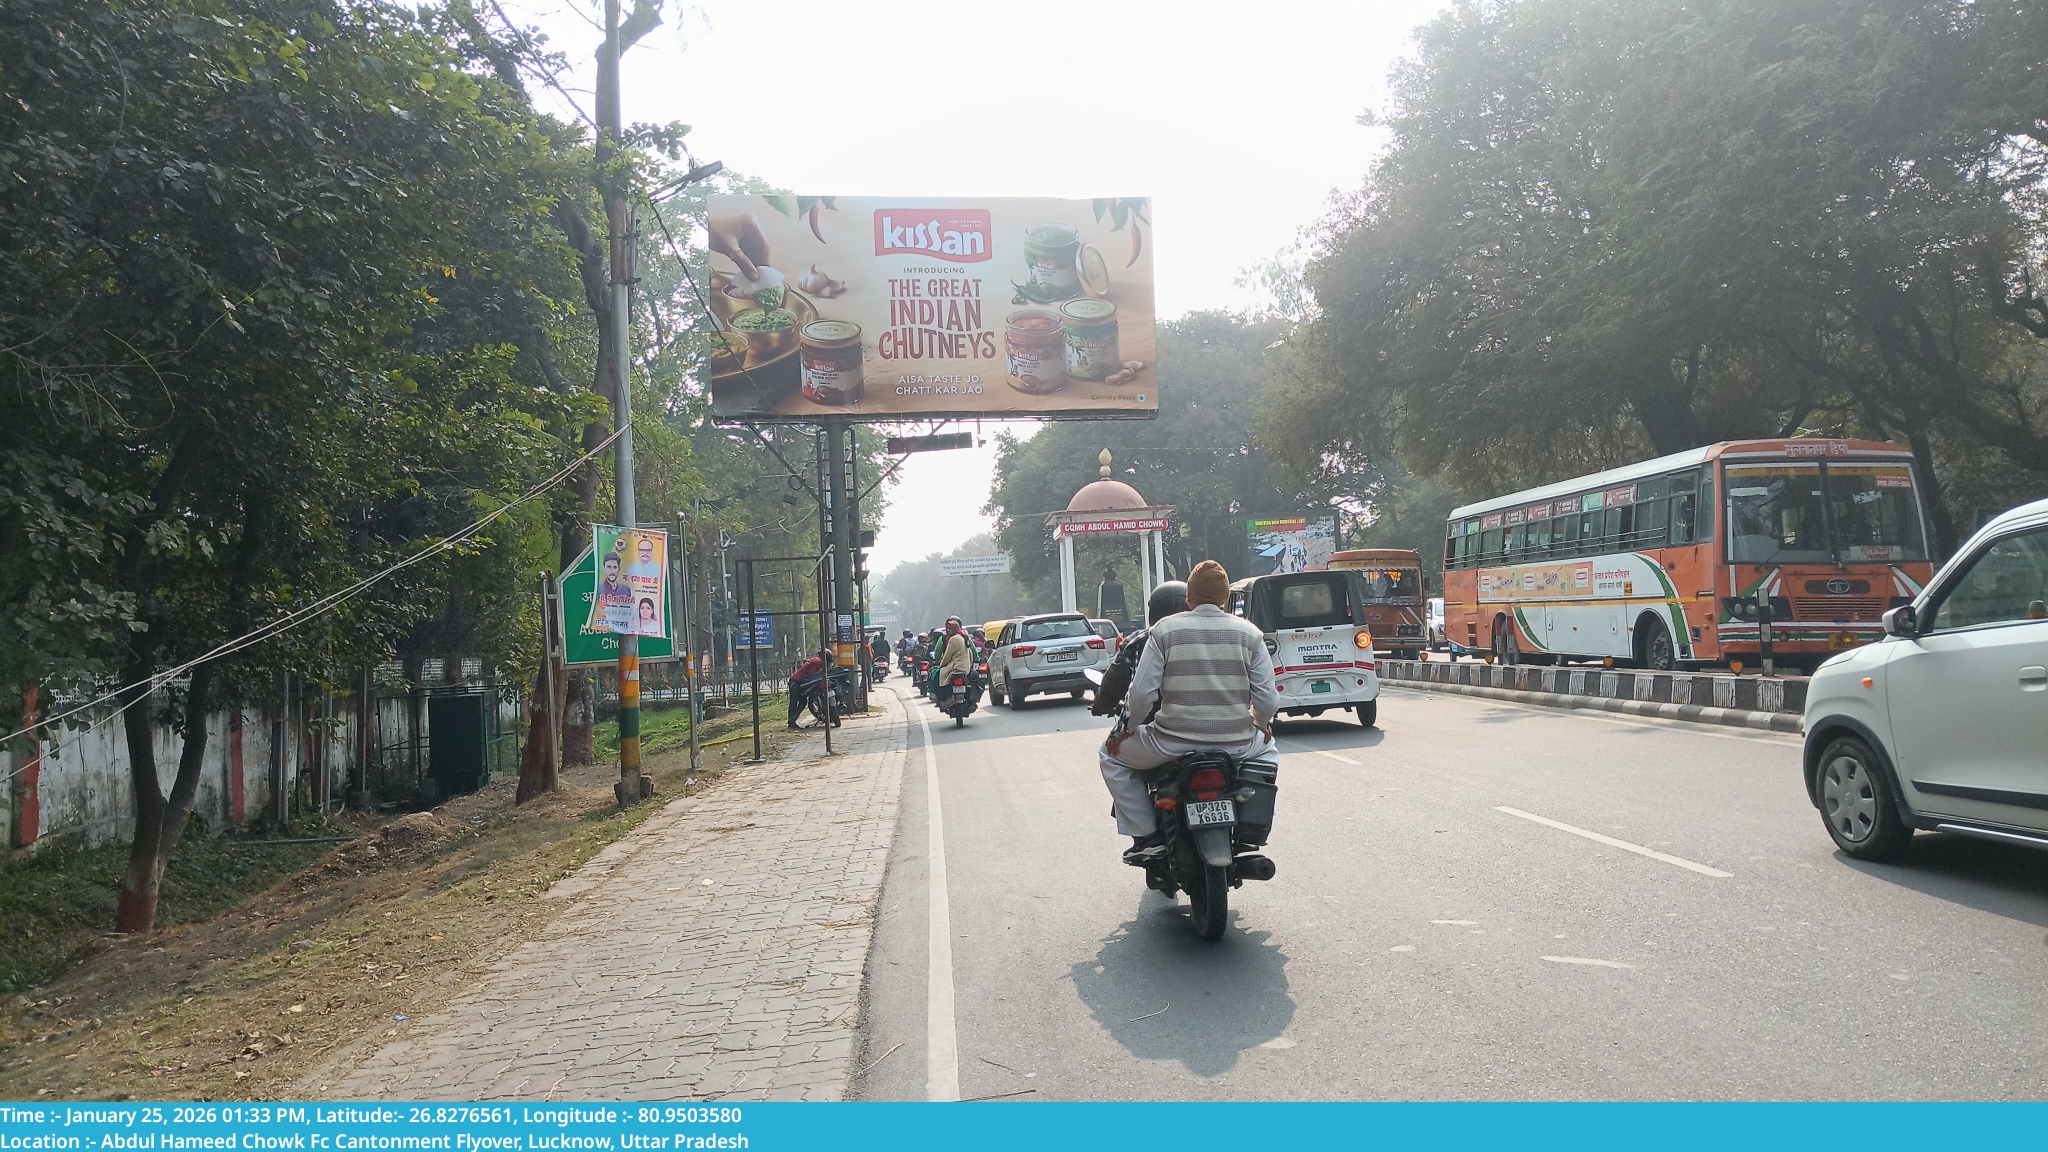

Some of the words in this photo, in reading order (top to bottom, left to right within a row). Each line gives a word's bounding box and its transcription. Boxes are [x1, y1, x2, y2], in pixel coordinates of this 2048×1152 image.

[882, 216, 985, 256] kissan
[888, 279, 921, 297] THE
[927, 279, 982, 297] GREAT
[890, 299, 981, 331] INDIAN
[878, 327, 997, 360] CHUTNEYS
[899, 375, 925, 384] AISA
[928, 375, 962, 383] TASTE
[966, 375, 980, 383] JO
[895, 386, 932, 395] CHATT
[935, 386, 958, 394] KAR
[962, 386, 983, 394] JAO
[1064, 523, 1086, 532] CQMH
[1087, 522, 1111, 531] ABDUL
[1113, 520, 1137, 529] HAMID
[1138, 519, 1165, 528] CHOWK
[1297, 643, 1338, 653] MONTRA
[1195, 801, 1227, 813] UP32G
